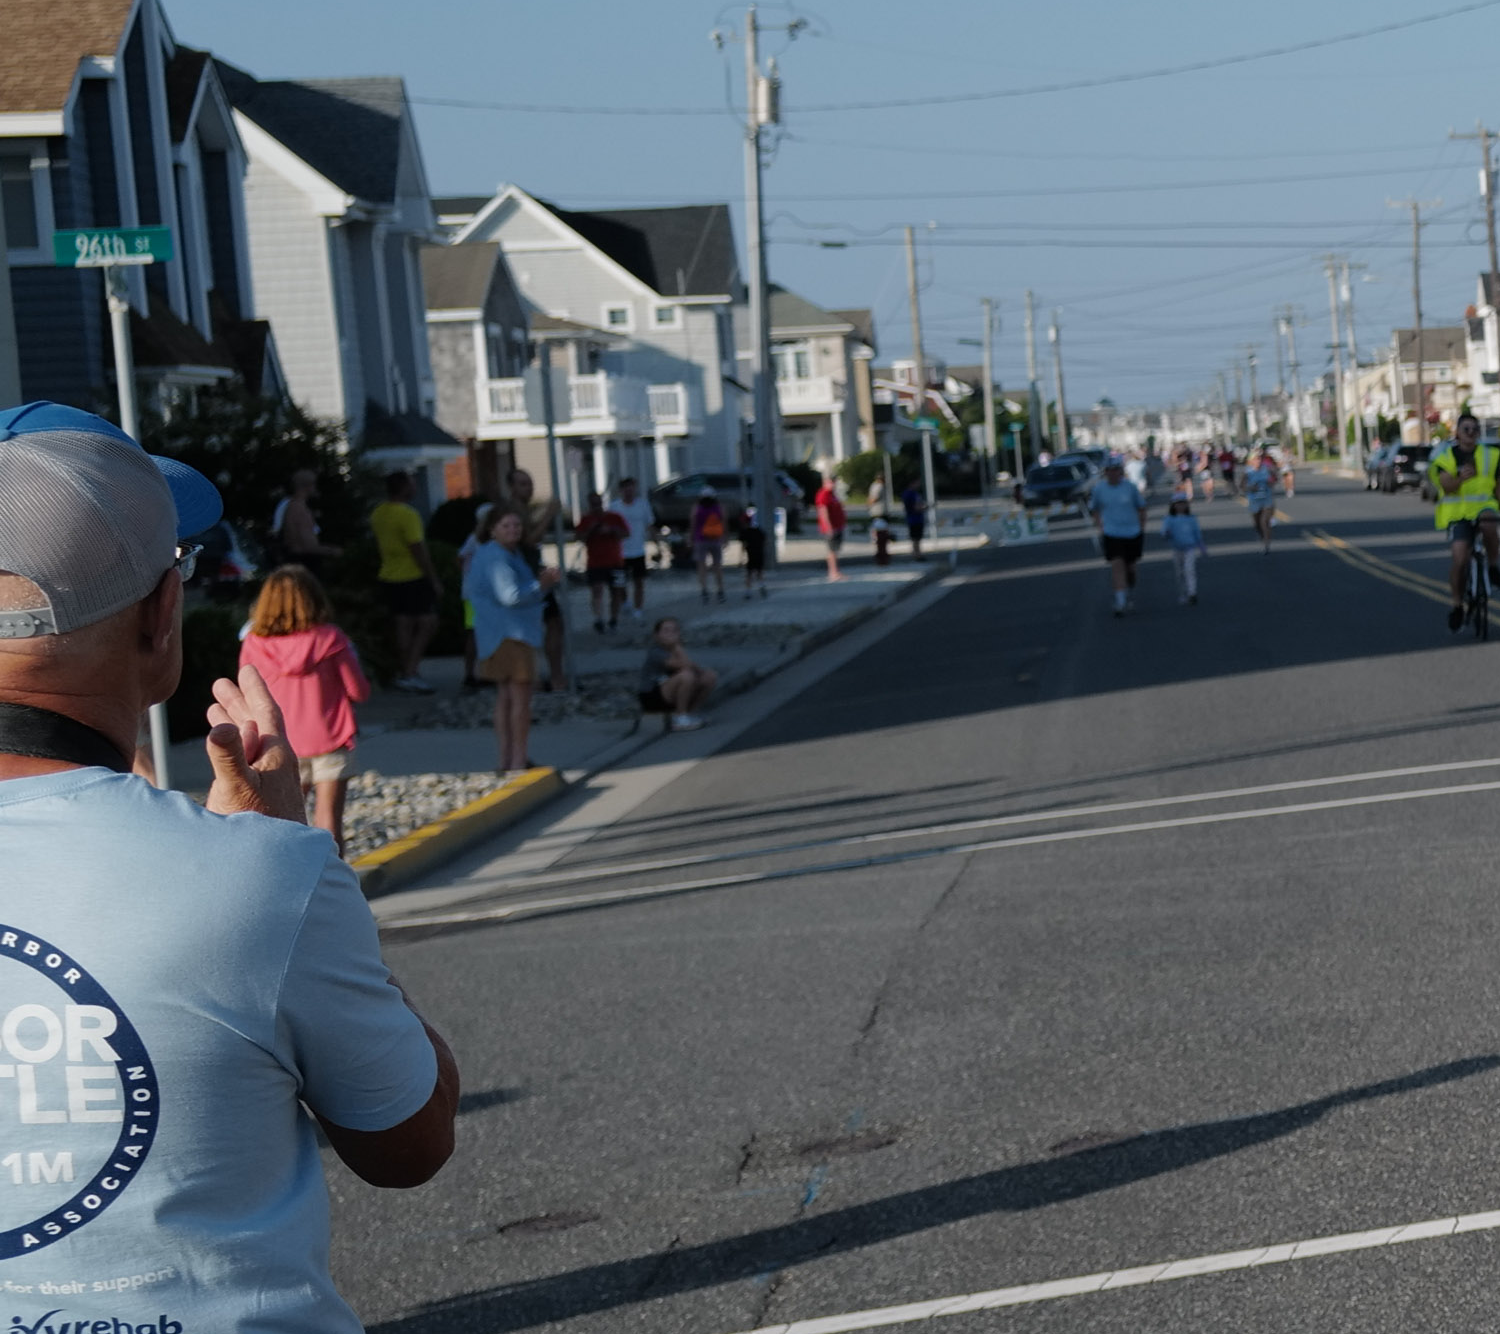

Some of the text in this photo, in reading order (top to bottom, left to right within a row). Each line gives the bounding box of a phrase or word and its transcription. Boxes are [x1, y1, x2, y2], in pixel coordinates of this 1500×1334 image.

[75, 232, 127, 259] 96th
[0, 1003, 123, 1064] OR
[0, 1064, 124, 1124] LE
[1, 1151, 75, 1185] 1M
[21, 1065, 152, 1248] ASSOCIATION
[4, 1265, 176, 1295] for their support
